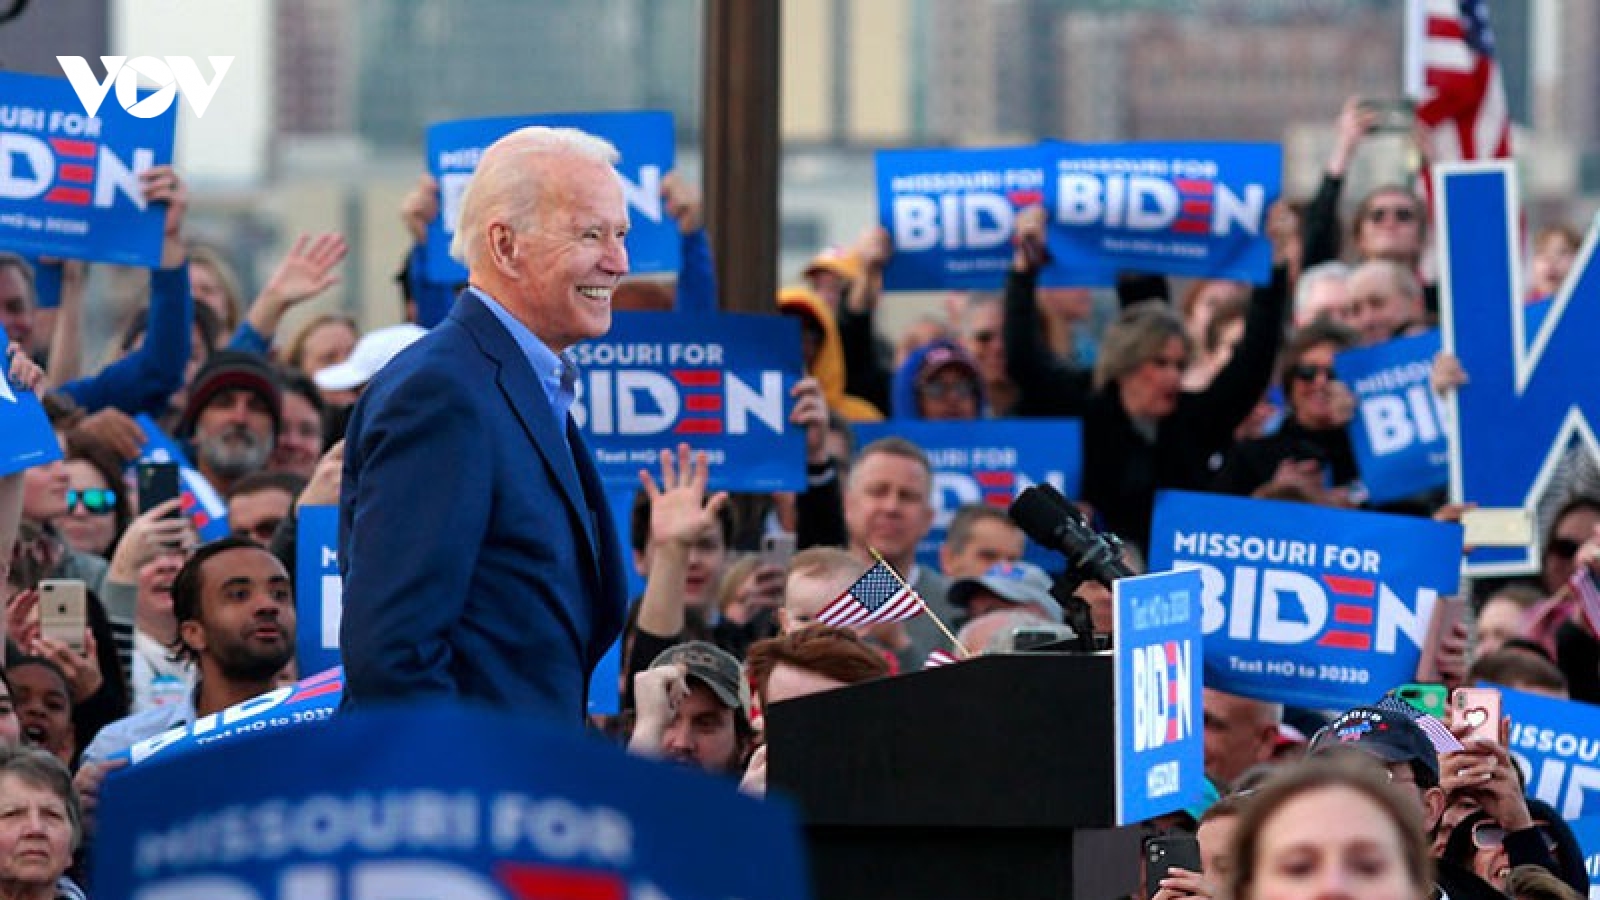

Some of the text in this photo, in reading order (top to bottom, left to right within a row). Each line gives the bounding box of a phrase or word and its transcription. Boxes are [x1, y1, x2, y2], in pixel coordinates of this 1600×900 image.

[1057, 174, 1264, 236] BIDEN
[668, 343, 725, 365] FOR
[1173, 530, 1382, 573] MISSOURI FOR
[1229, 655, 1263, 672] Text
[1266, 659, 1295, 676] MO
[1132, 639, 1192, 752] BIDEN
[489, 790, 635, 866] FOR
